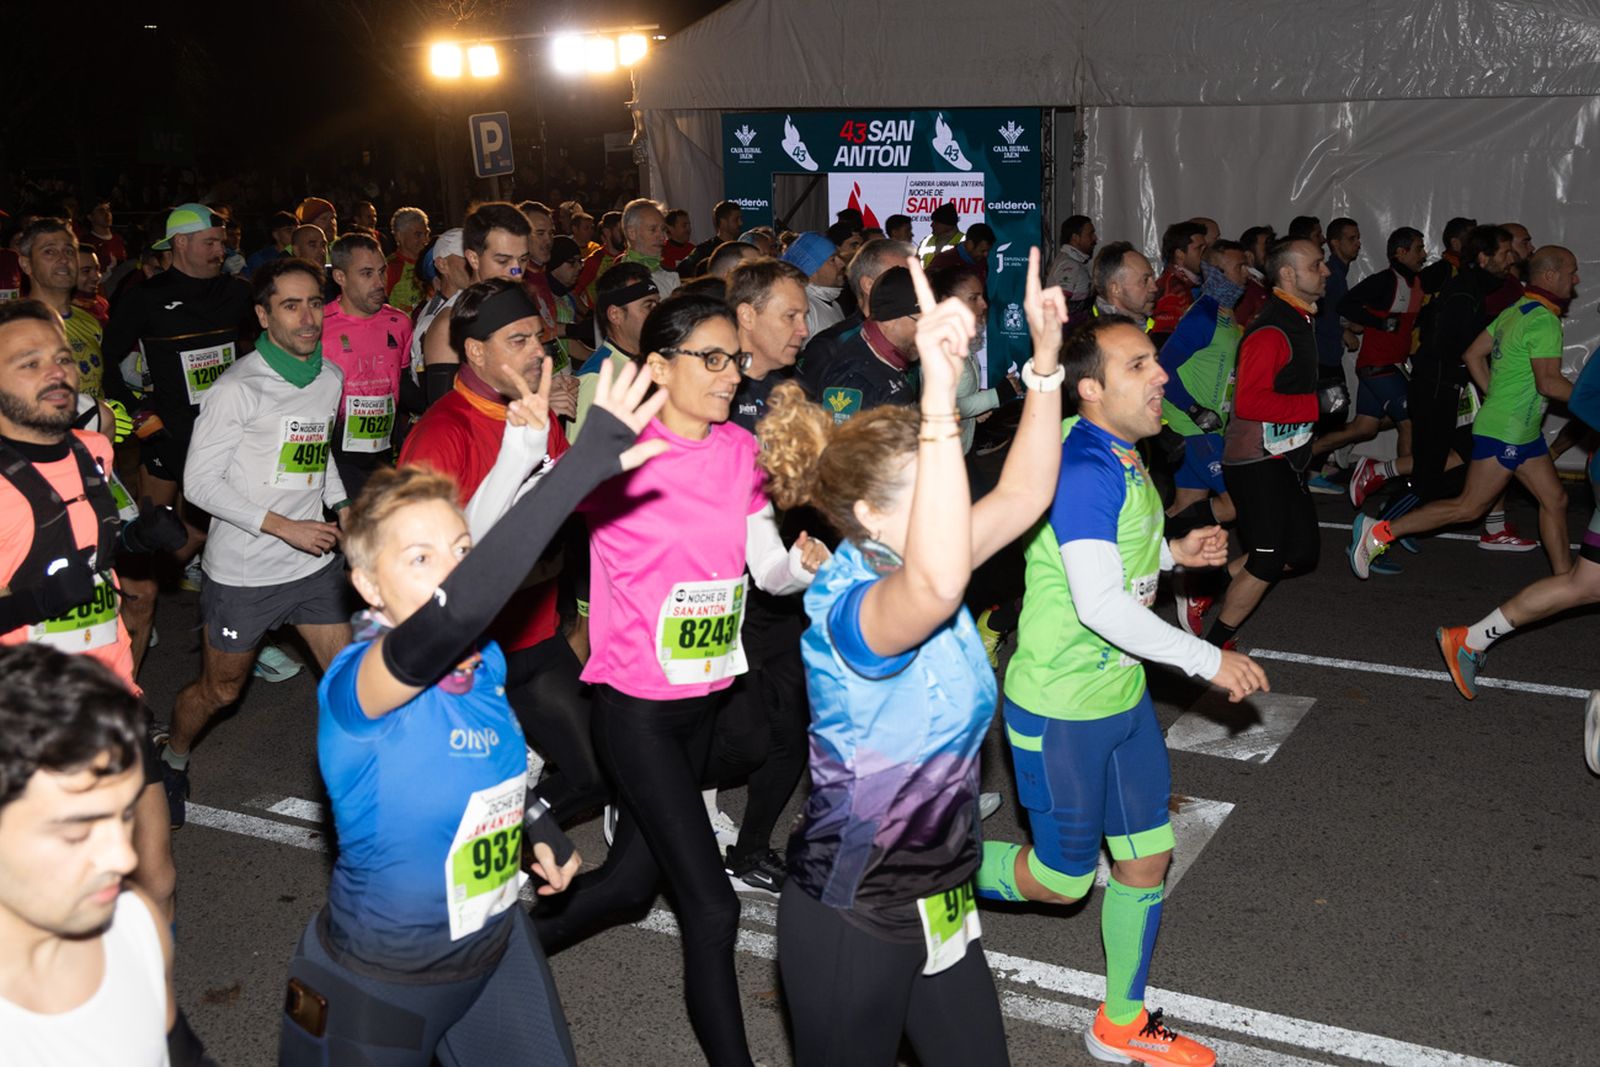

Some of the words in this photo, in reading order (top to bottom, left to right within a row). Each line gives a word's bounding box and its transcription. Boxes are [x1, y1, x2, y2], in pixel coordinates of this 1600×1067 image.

[480, 121, 503, 169] P
[833, 139, 911, 167] ANTÓN
[943, 144, 959, 162] 43
[792, 146, 806, 162] 43
[908, 188, 934, 197] NOCHE
[934, 189, 944, 197] DE
[906, 197, 942, 214] SAN
[987, 200, 1036, 210] calderón
[290, 433, 304, 442] SAN
[292, 444, 329, 466] 4919
[688, 592, 715, 603] NOCHE
[716, 592, 727, 601] DE
[673, 605, 694, 616] SAN
[679, 615, 735, 648] 8243
